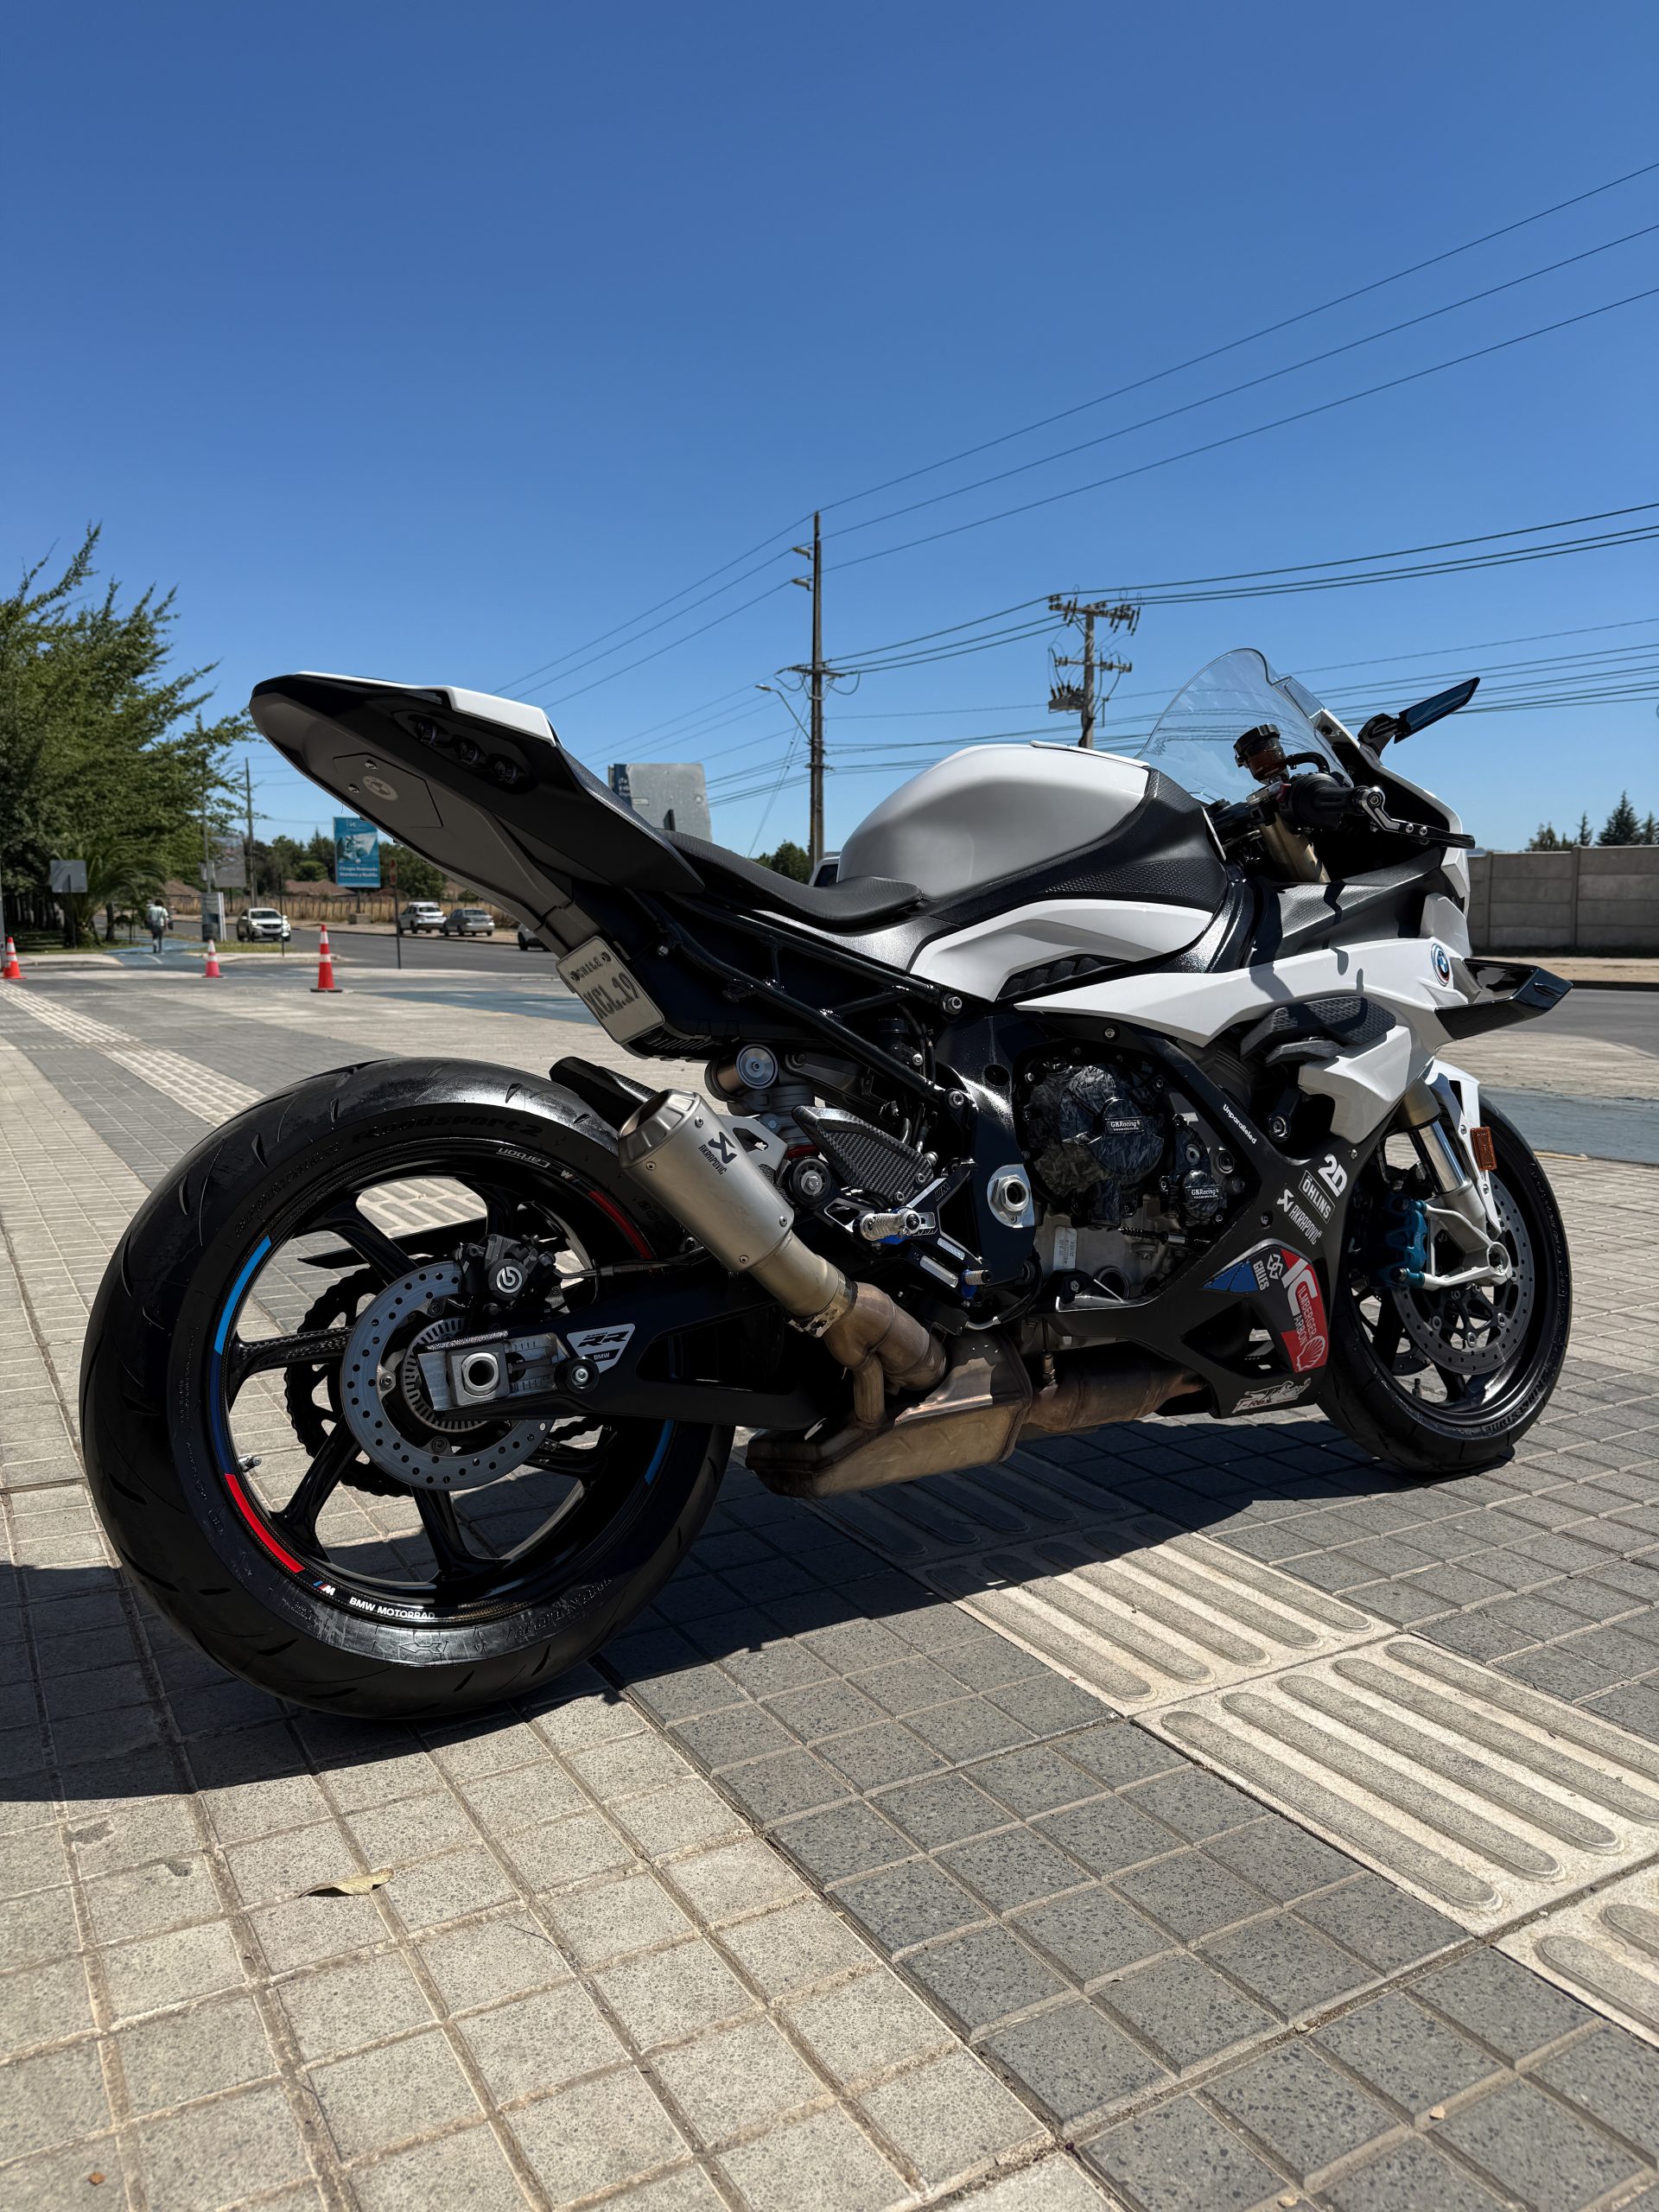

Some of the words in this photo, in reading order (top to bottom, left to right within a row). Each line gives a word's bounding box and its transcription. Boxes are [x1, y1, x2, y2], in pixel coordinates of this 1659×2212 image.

[1223, 1104, 1256, 1144] Unparalleled
[496, 1147, 550, 1167] Carbon
[1302, 1175, 1332, 1218] ÖHLINS
[1253, 1261, 1269, 1291] GILLES
[1298, 1286, 1317, 1338] ILMBERGER
[349, 1597, 375, 1611] BMW
[377, 1605, 436, 1619] MOTORRAD
